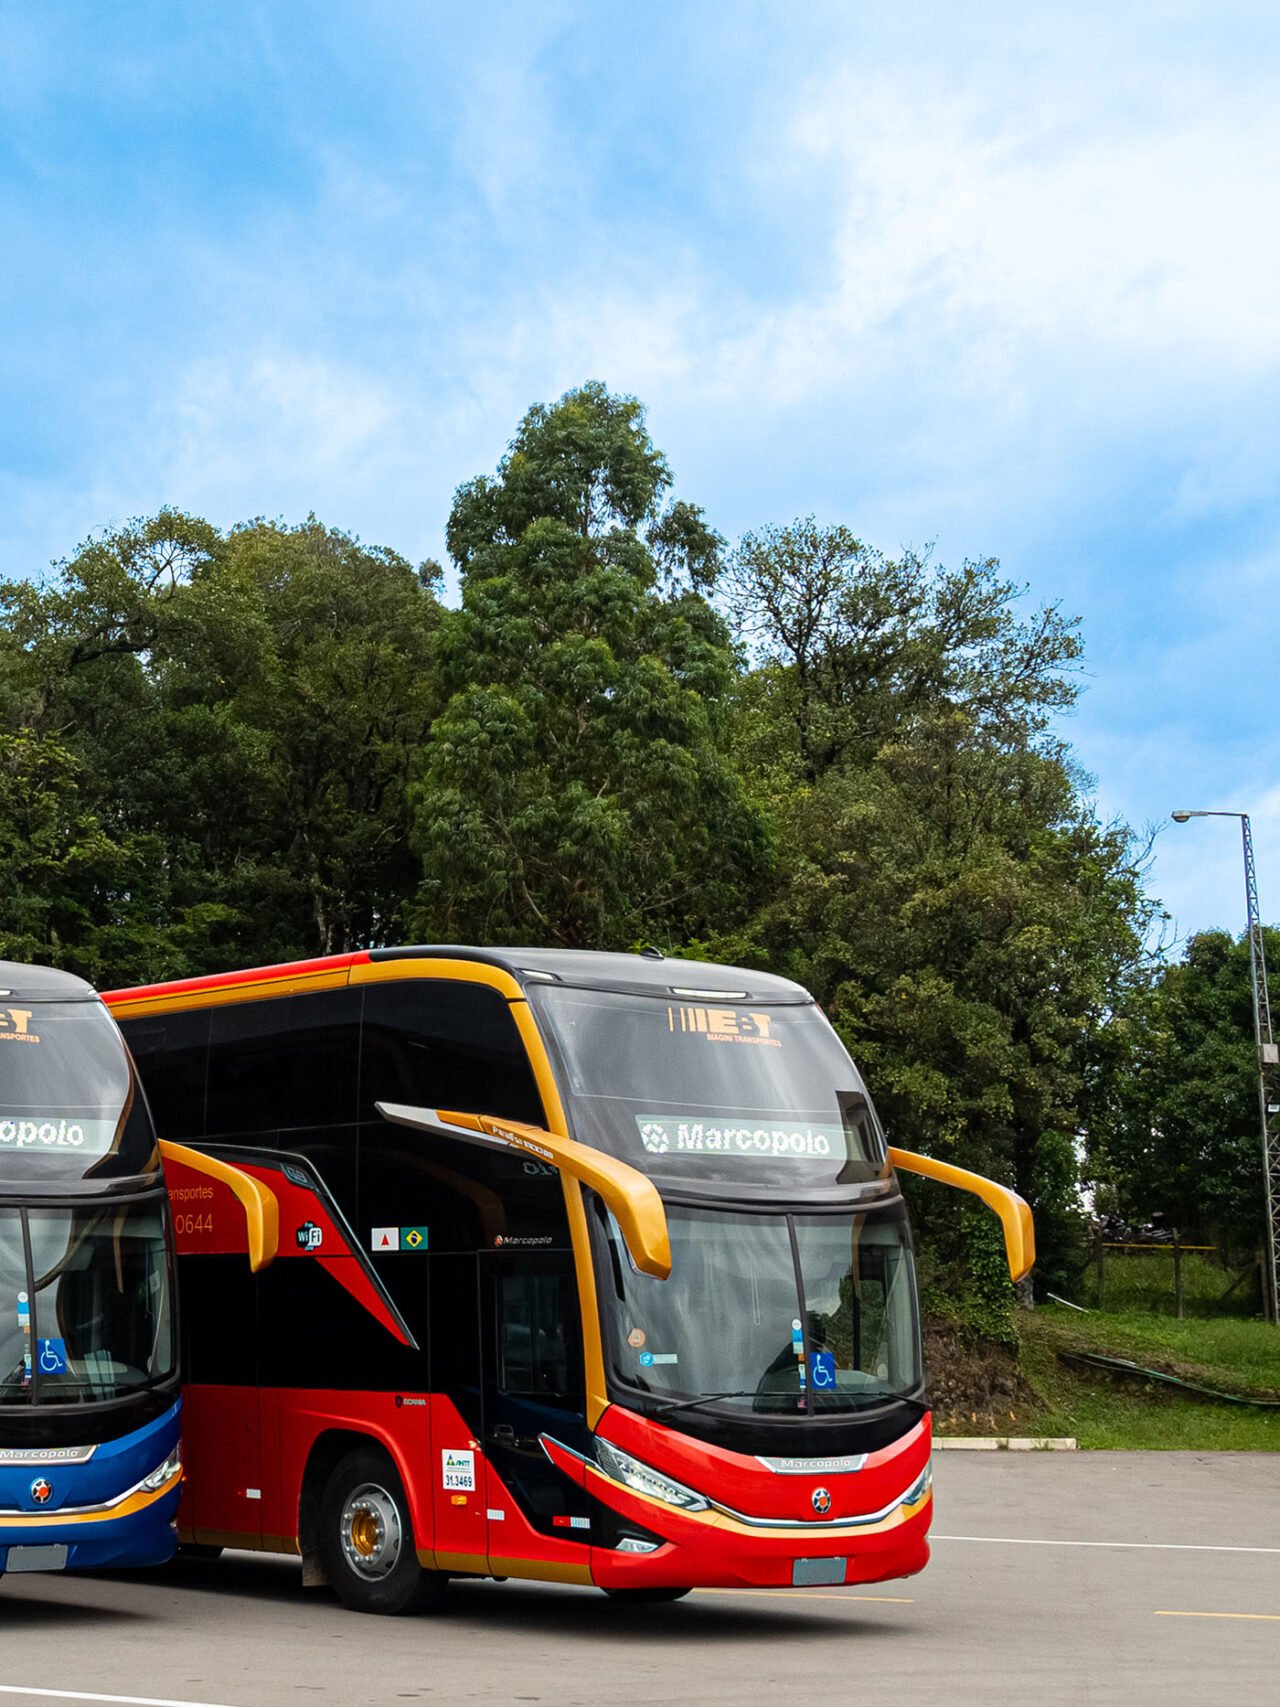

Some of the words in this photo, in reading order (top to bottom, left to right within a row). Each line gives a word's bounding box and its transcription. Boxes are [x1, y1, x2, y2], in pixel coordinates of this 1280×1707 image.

[677, 1123, 830, 1155] Marcopolo
[168, 1186, 214, 1202] ansportes
[175, 1214, 214, 1234] 0644
[0, 1448, 79, 1459] Marcopolo
[781, 1458, 851, 1469] Marcopolo
